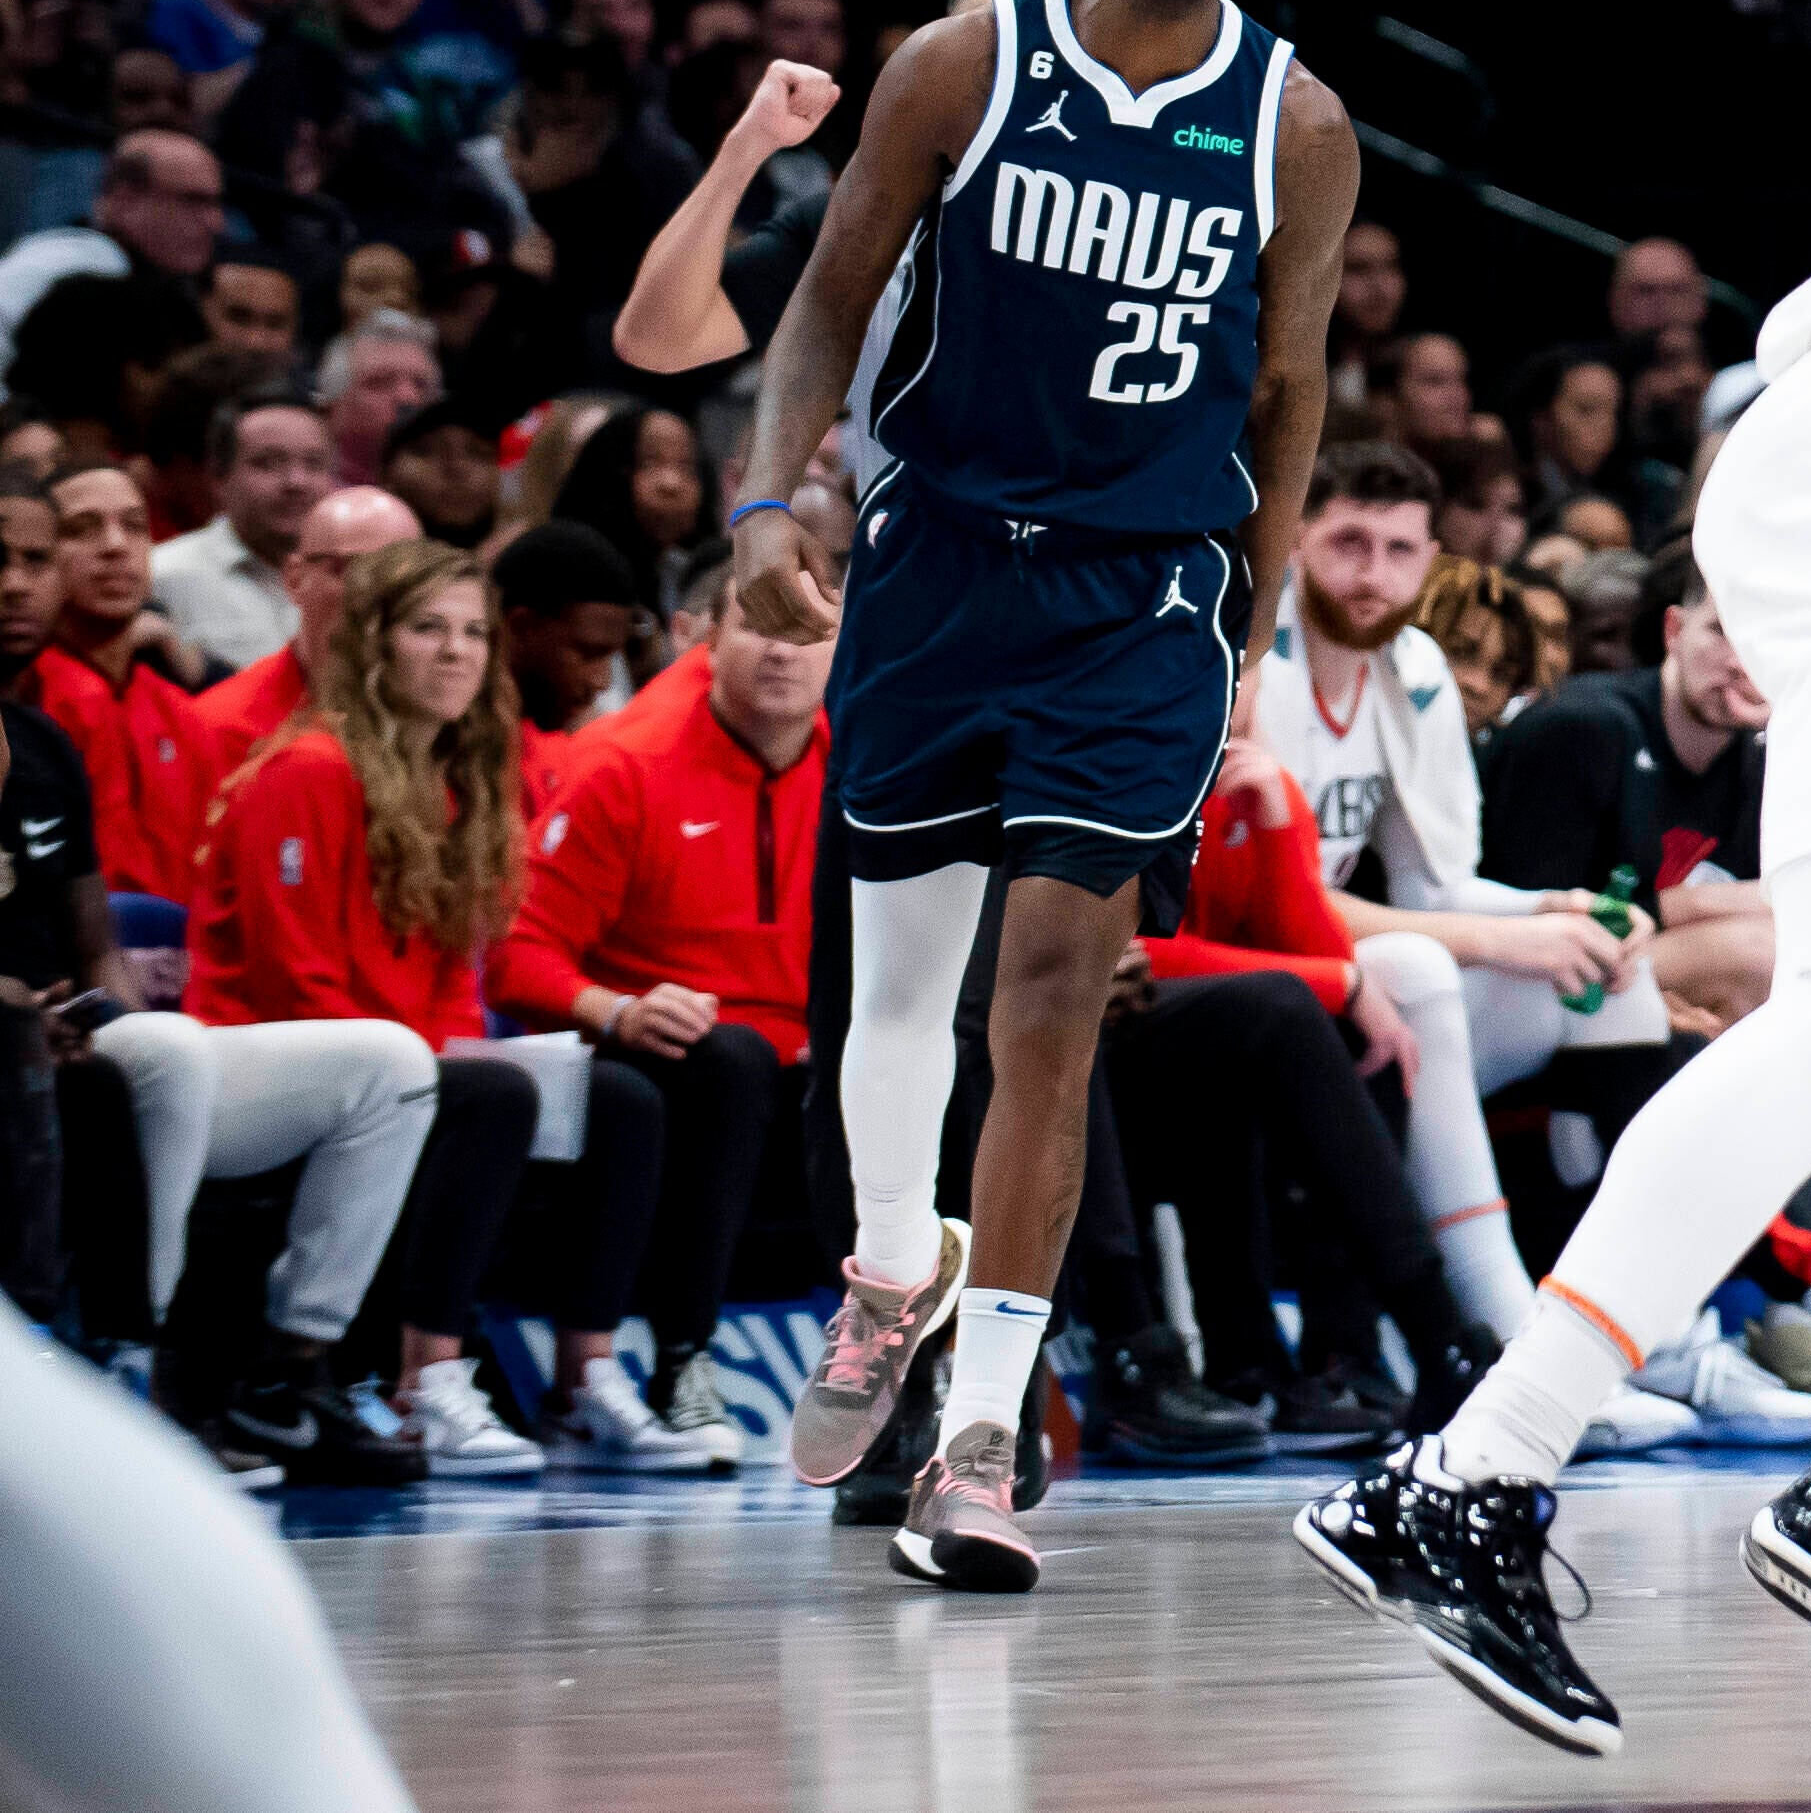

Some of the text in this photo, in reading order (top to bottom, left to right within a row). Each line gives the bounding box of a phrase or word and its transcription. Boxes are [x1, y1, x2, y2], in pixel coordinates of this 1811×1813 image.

[1029, 51, 1055, 80] 6
[1173, 125, 1244, 156] chime
[1088, 301, 1211, 404] 25
